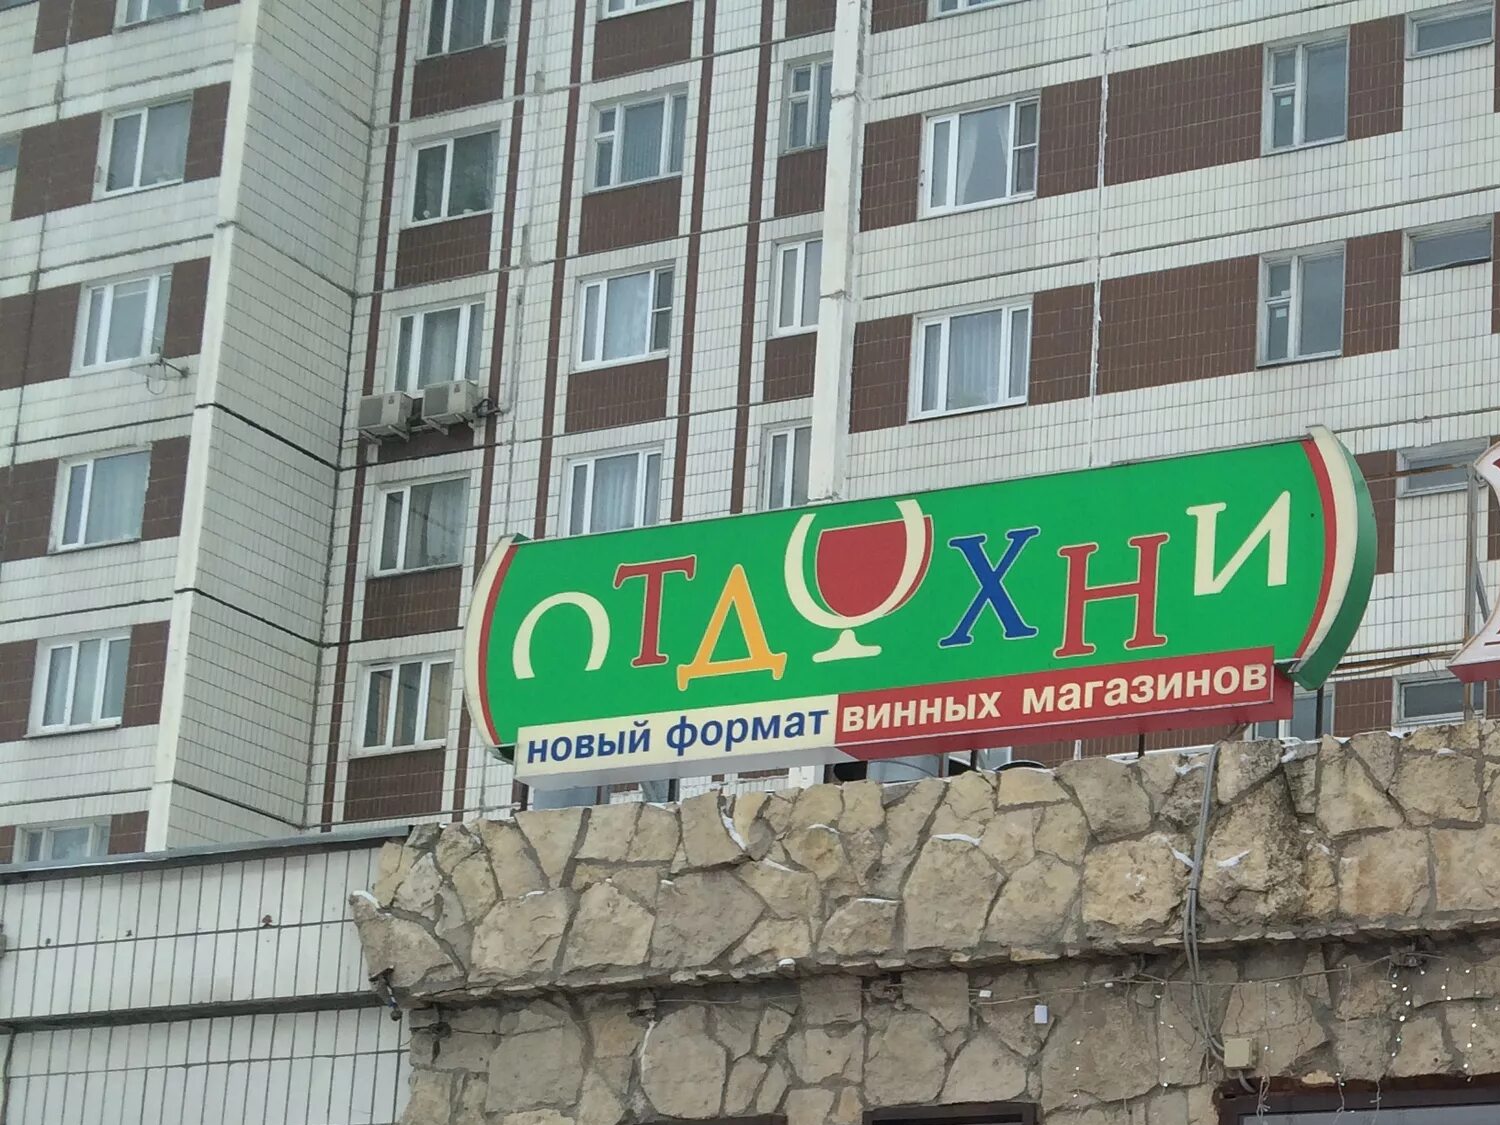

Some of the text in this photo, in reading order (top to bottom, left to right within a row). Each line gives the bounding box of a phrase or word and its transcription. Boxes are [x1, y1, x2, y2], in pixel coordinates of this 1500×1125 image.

[512, 489, 1291, 692] ОТДОХНИ
[526, 663, 1268, 764] новый формат винных магазинов
